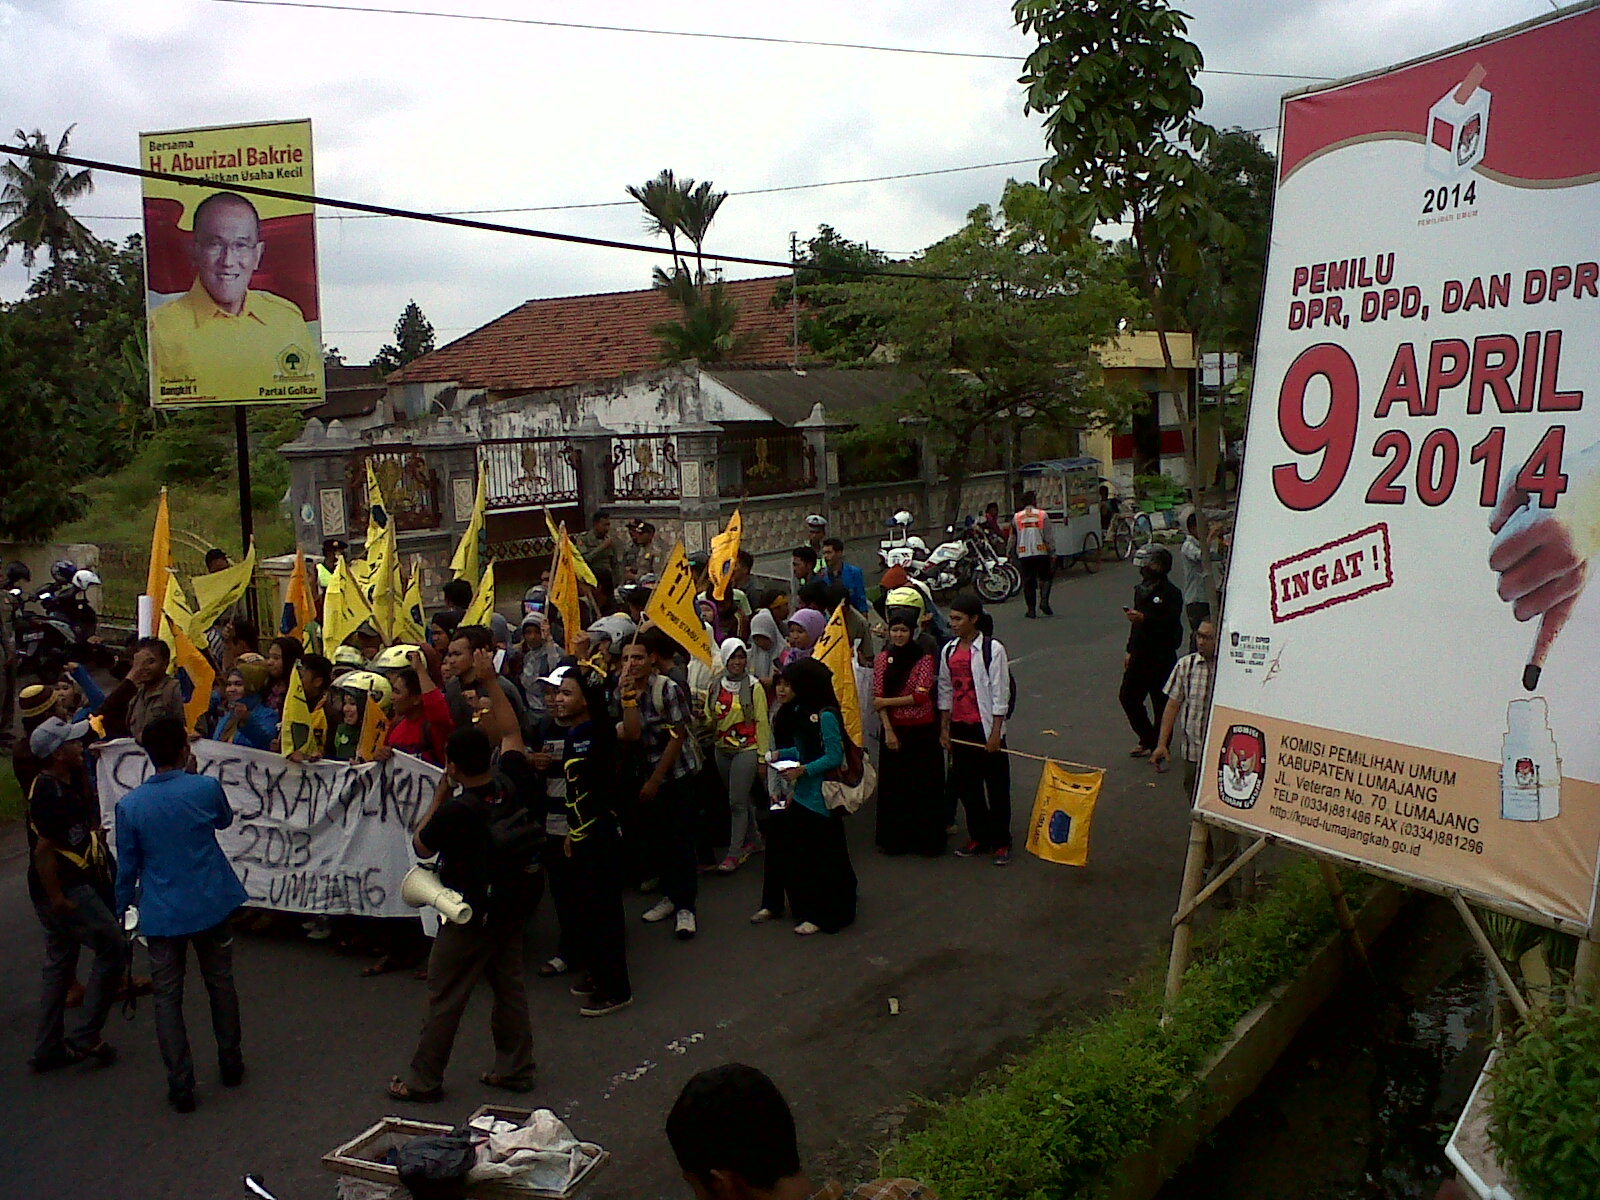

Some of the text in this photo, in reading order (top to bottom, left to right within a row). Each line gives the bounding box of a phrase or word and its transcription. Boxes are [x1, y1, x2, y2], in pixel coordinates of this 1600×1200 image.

[149, 140, 194, 151] Bersama
[171, 148, 242, 172] Aburizal
[246, 144, 303, 167] Bakrie
[241, 170, 274, 182] Usaha
[276, 167, 303, 179] Kecil
[1422, 180, 1476, 214] 2014
[1288, 262, 1599, 331] DPR, DPD, DAN DPR
[1292, 252, 1395, 296] PEMILU
[1271, 330, 1584, 511] 9 APRIL
[1364, 425, 1568, 509] 2014
[1281, 552, 1364, 602] INGAT
[1277, 752, 1438, 803] KABUPATEN LUMAJANG
[1280, 735, 1457, 787] KOMISI PEMILIHAN UMUM
[1273, 787, 1299, 804] TELP
[1374, 815, 1398, 832] FAX
[1296, 776, 1340, 798] Veteran
[1395, 800, 1480, 834] LUMAJANG
[233, 824, 312, 868] 2013
